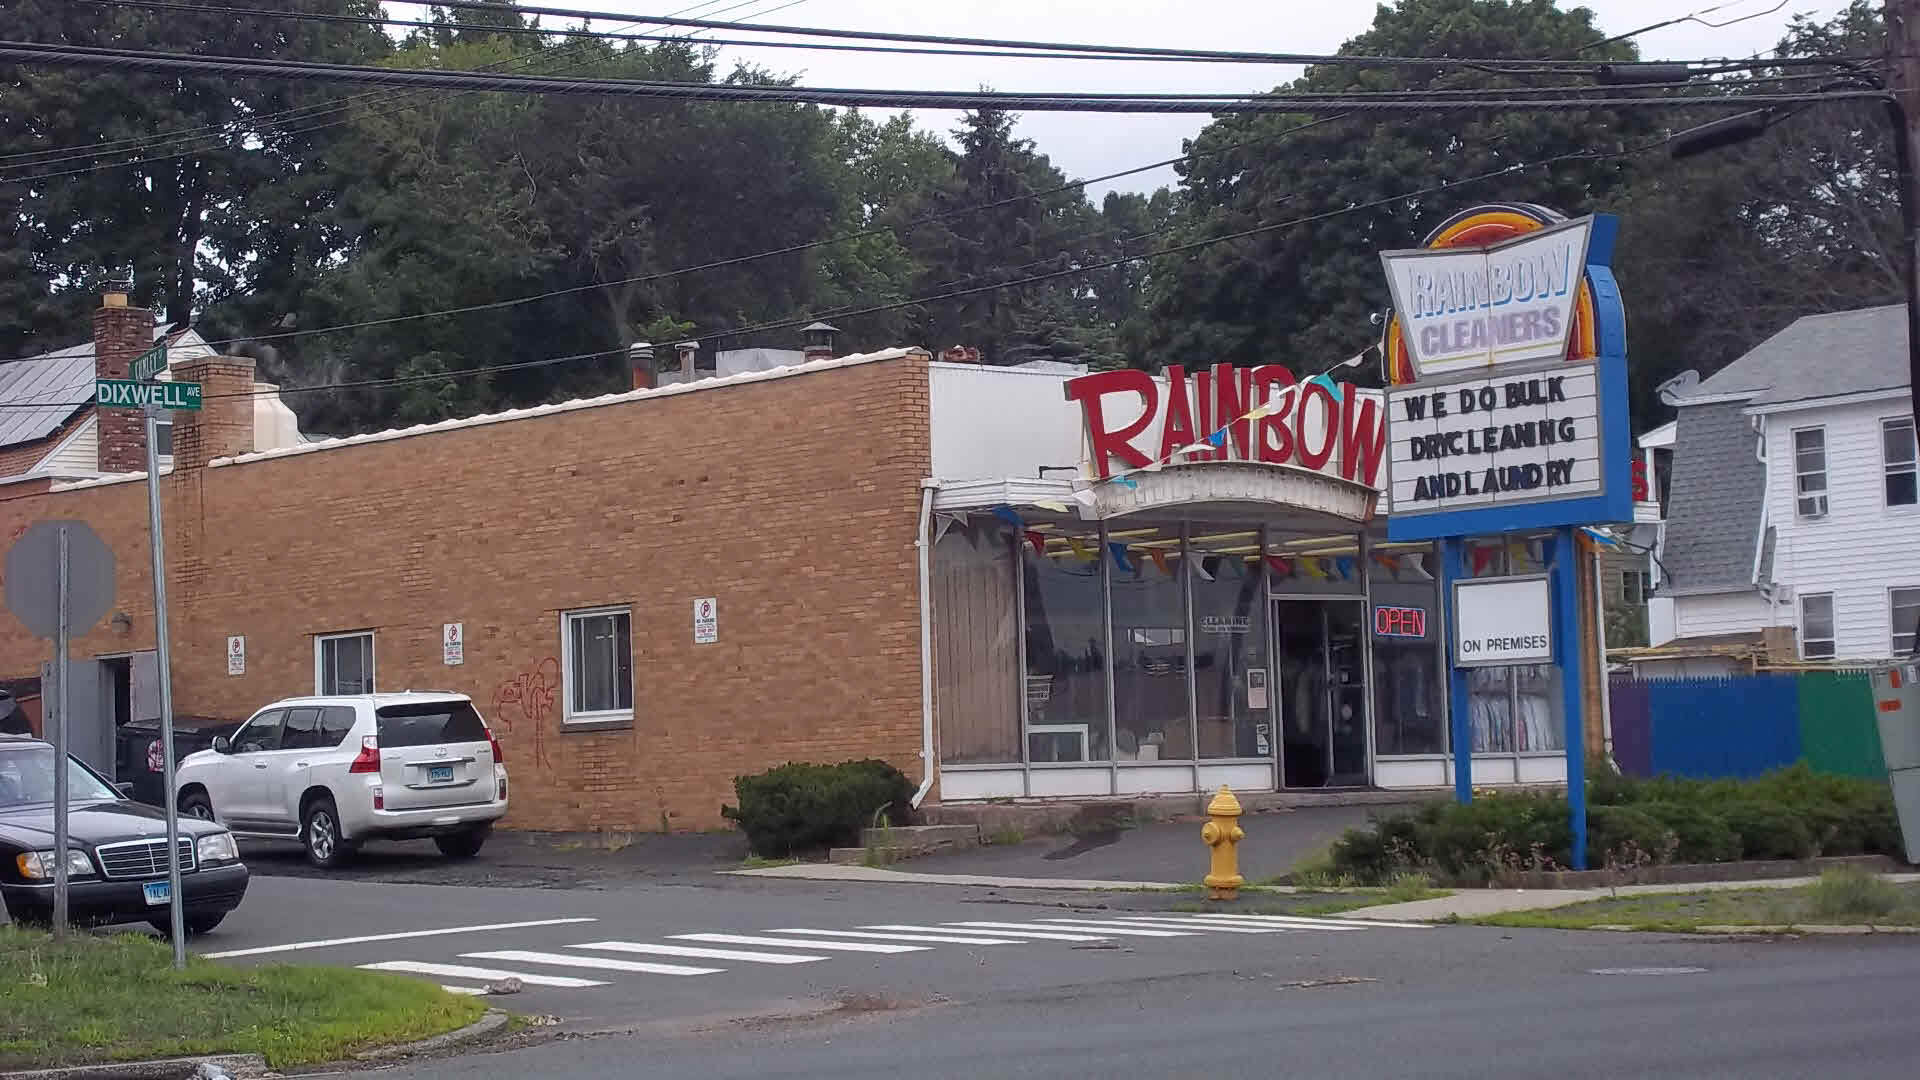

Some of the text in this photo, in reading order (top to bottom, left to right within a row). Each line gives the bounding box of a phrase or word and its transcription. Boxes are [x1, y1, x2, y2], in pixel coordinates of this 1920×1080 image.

[1409, 241, 1576, 318] RAINBOW
[1420, 306, 1562, 357] CLEANERS
[97, 383, 201, 406] DIXWELL AVE
[1404, 375, 1566, 422] WE DO BULK
[1065, 362, 1386, 488] RAINBOW
[1376, 608, 1425, 635] OPEN
[1463, 635, 1548, 653] ON PREMISES
